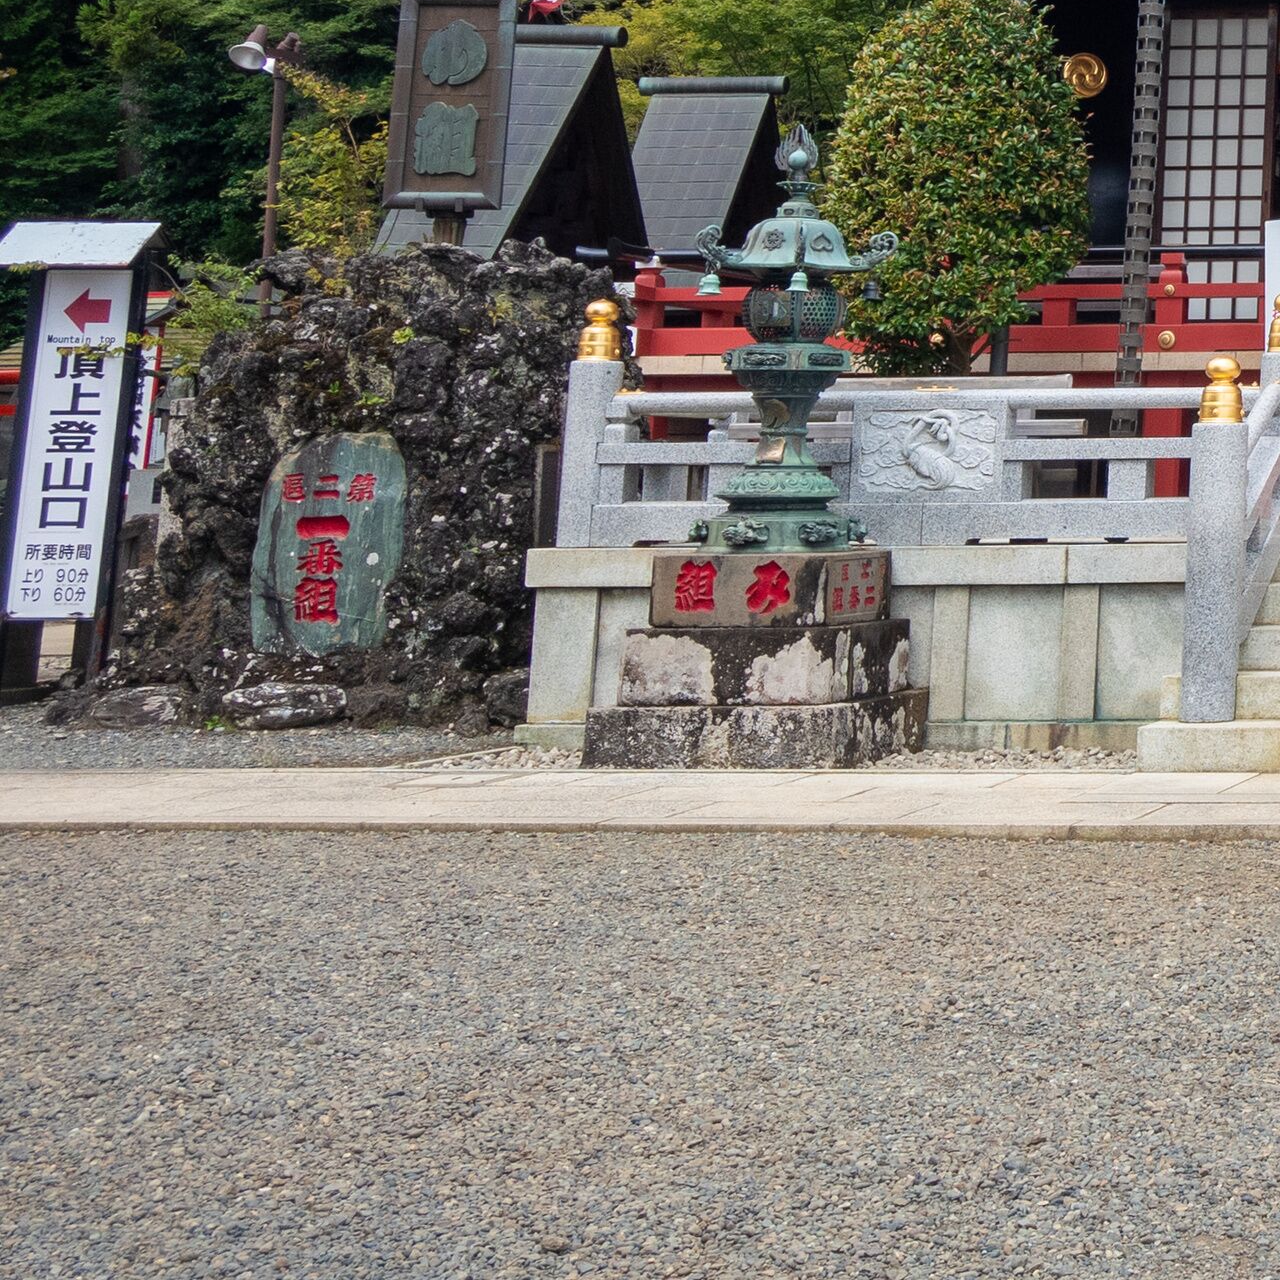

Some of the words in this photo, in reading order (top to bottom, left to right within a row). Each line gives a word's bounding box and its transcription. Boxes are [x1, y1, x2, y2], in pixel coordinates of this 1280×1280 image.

[47, 335, 91, 344] Mountain
[100, 335, 116, 345] top
[38, 347, 106, 529] 頂上登山口
[24, 544, 93, 561] 所要時間
[22, 568, 44, 584] 上り
[56, 568, 89, 583] 90分
[294, 516, 350, 624] 一番組
[20, 587, 41, 602] 下り
[53, 587, 86, 602] 60分
